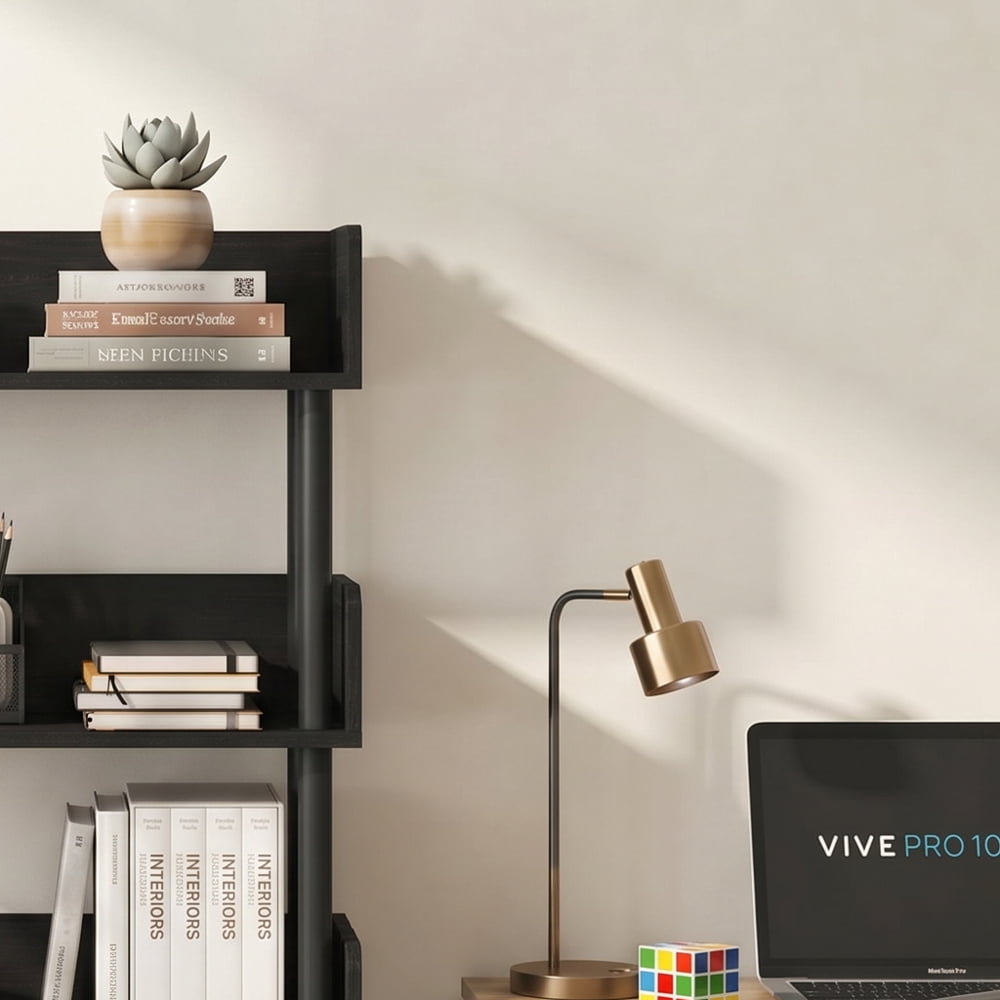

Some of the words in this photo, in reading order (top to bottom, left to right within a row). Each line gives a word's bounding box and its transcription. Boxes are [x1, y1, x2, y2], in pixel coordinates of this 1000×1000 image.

[818, 835, 896, 857] VIVE
[904, 834, 964, 857] PRO
[150, 854, 164, 940] INTERIORS
[186, 854, 200, 940] INTERIORS
[222, 854, 236, 940] INTERIORS
[258, 854, 271, 940] INTERIORS
